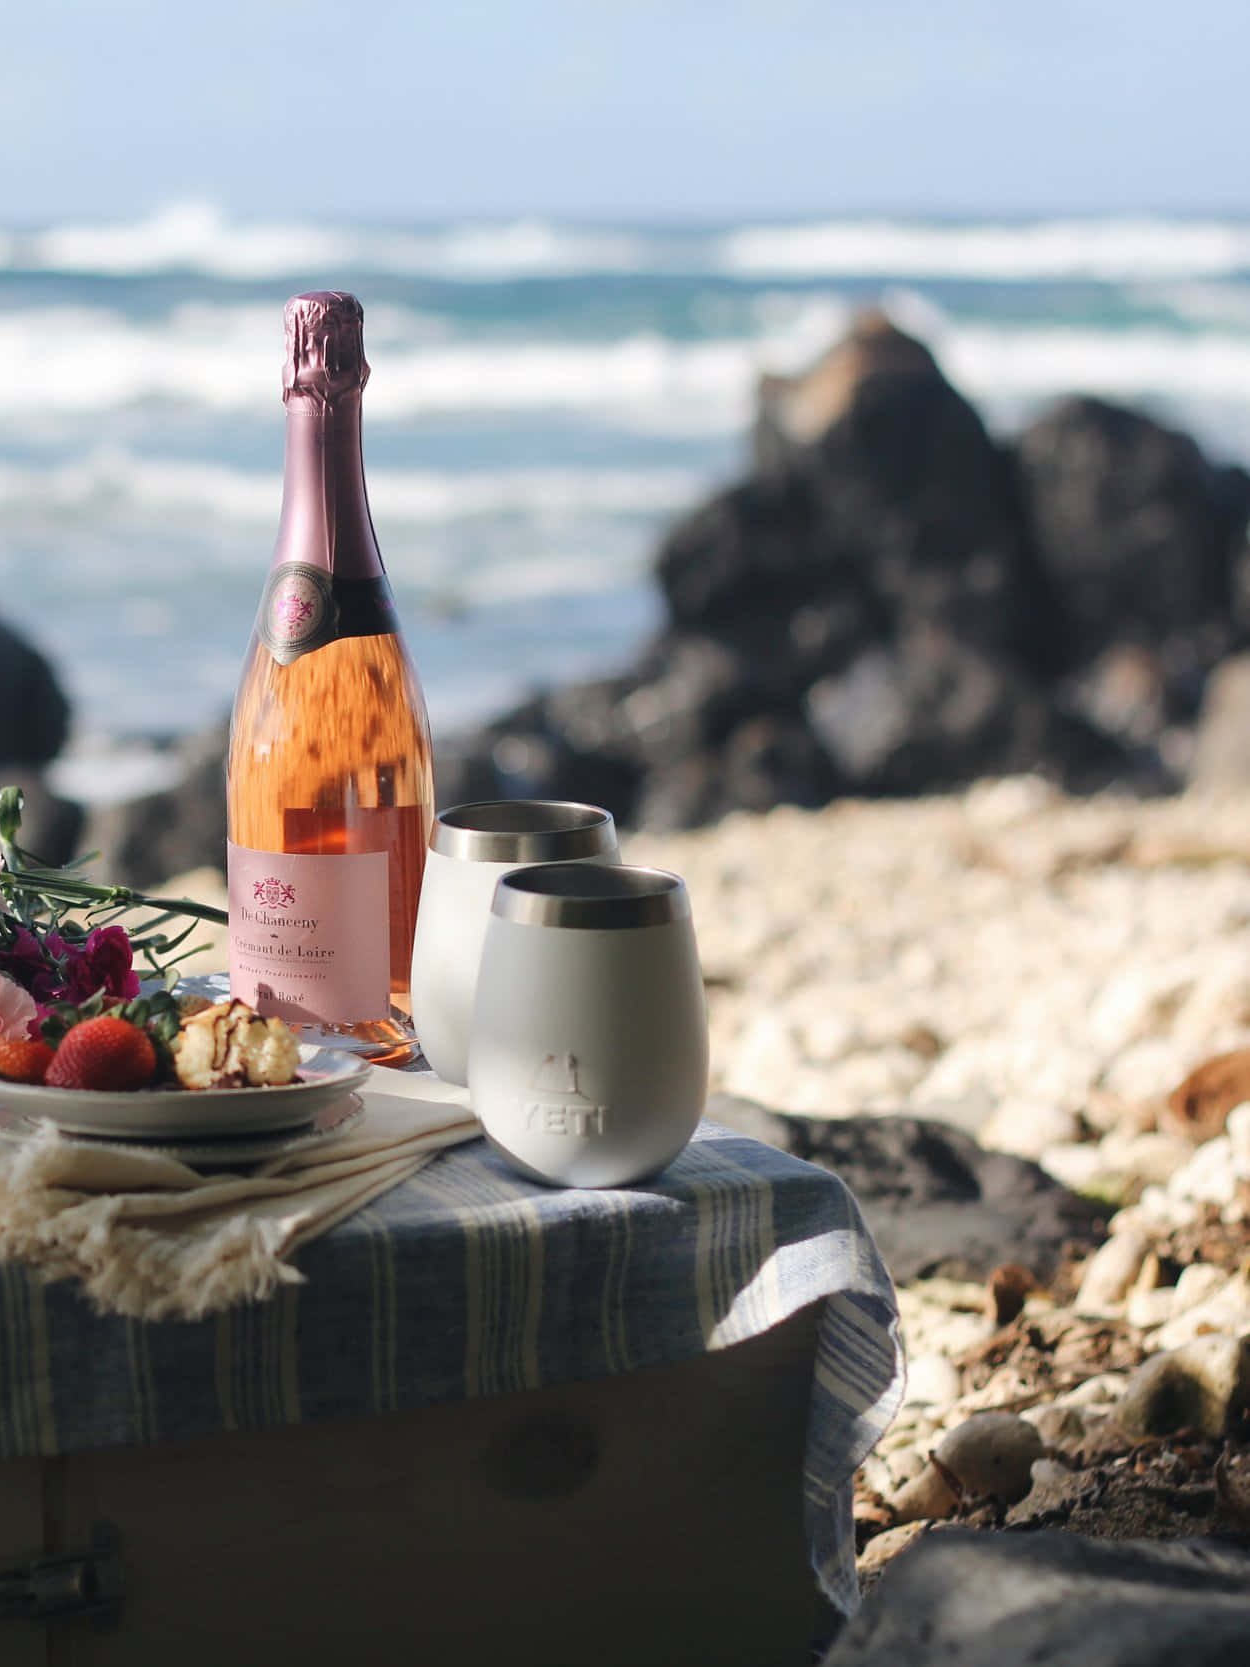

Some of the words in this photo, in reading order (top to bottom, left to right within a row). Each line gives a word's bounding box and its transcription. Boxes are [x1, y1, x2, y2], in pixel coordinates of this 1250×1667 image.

[240, 906, 253, 921] De
[255, 910, 319, 935] Chanceny
[277, 943, 292, 957] de
[297, 945, 335, 959] Loire
[278, 989, 305, 1003] Rosé
[520, 1103, 608, 1137] YETI
